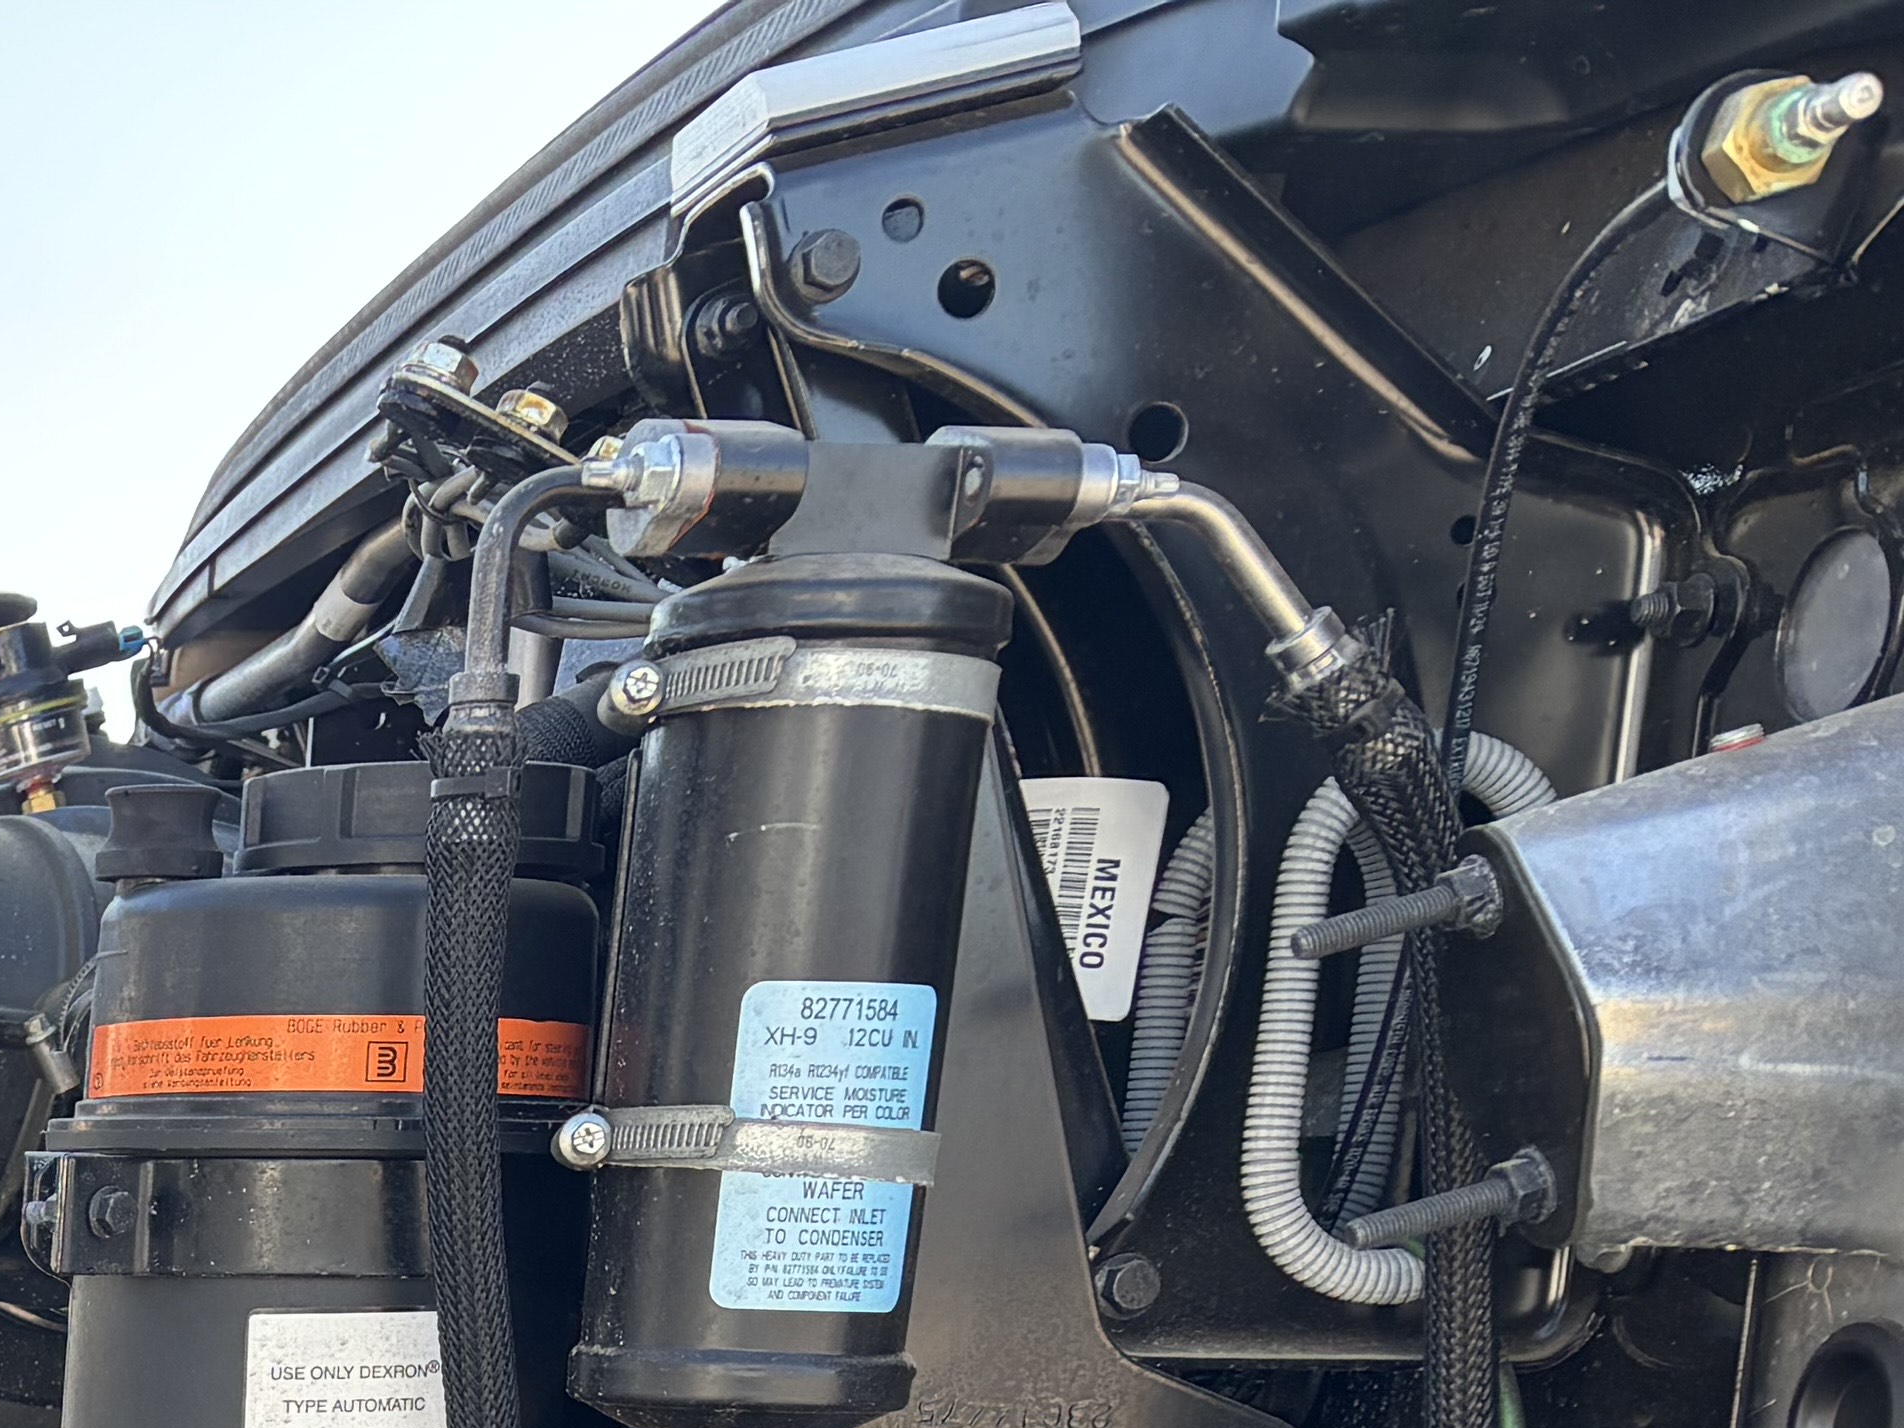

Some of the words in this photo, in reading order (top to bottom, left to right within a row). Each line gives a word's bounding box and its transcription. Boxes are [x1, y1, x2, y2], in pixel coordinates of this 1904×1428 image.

[1080, 859, 1121, 969] MEXICO
[800, 997, 899, 1021] 82771584
[287, 1018, 323, 1033] BOGE
[333, 1018, 387, 1034] Rubber
[397, 1020, 405, 1034] &
[764, 1027, 818, 1046] XH-9
[769, 1064, 801, 1078] R134a
[769, 1086, 835, 1100] SERVICE
[844, 1087, 908, 1103] MOISTURE
[760, 1104, 833, 1118] INDICATOR
[843, 1105, 868, 1119] PER
[875, 1106, 910, 1120] COLOR
[803, 1181, 864, 1200] WAFER
[766, 1207, 841, 1224] CONNECT
[849, 1209, 887, 1225] INLET
[765, 1228, 786, 1245] TO
[798, 1229, 884, 1246] CONDENSER
[741, 1250, 757, 1261] THIS
[762, 1250, 787, 1261] HEAVY
[791, 1252, 811, 1261] DUTY
[815, 1252, 834, 1262] PART
[783, 1278, 804, 1288] LEAD
[767, 1290, 783, 1300] AND
[271, 1366, 305, 1380] USE
[310, 1366, 355, 1379] ONLY
[283, 1400, 327, 1414] TYPE
[332, 1397, 426, 1413] AUTOMATIC
